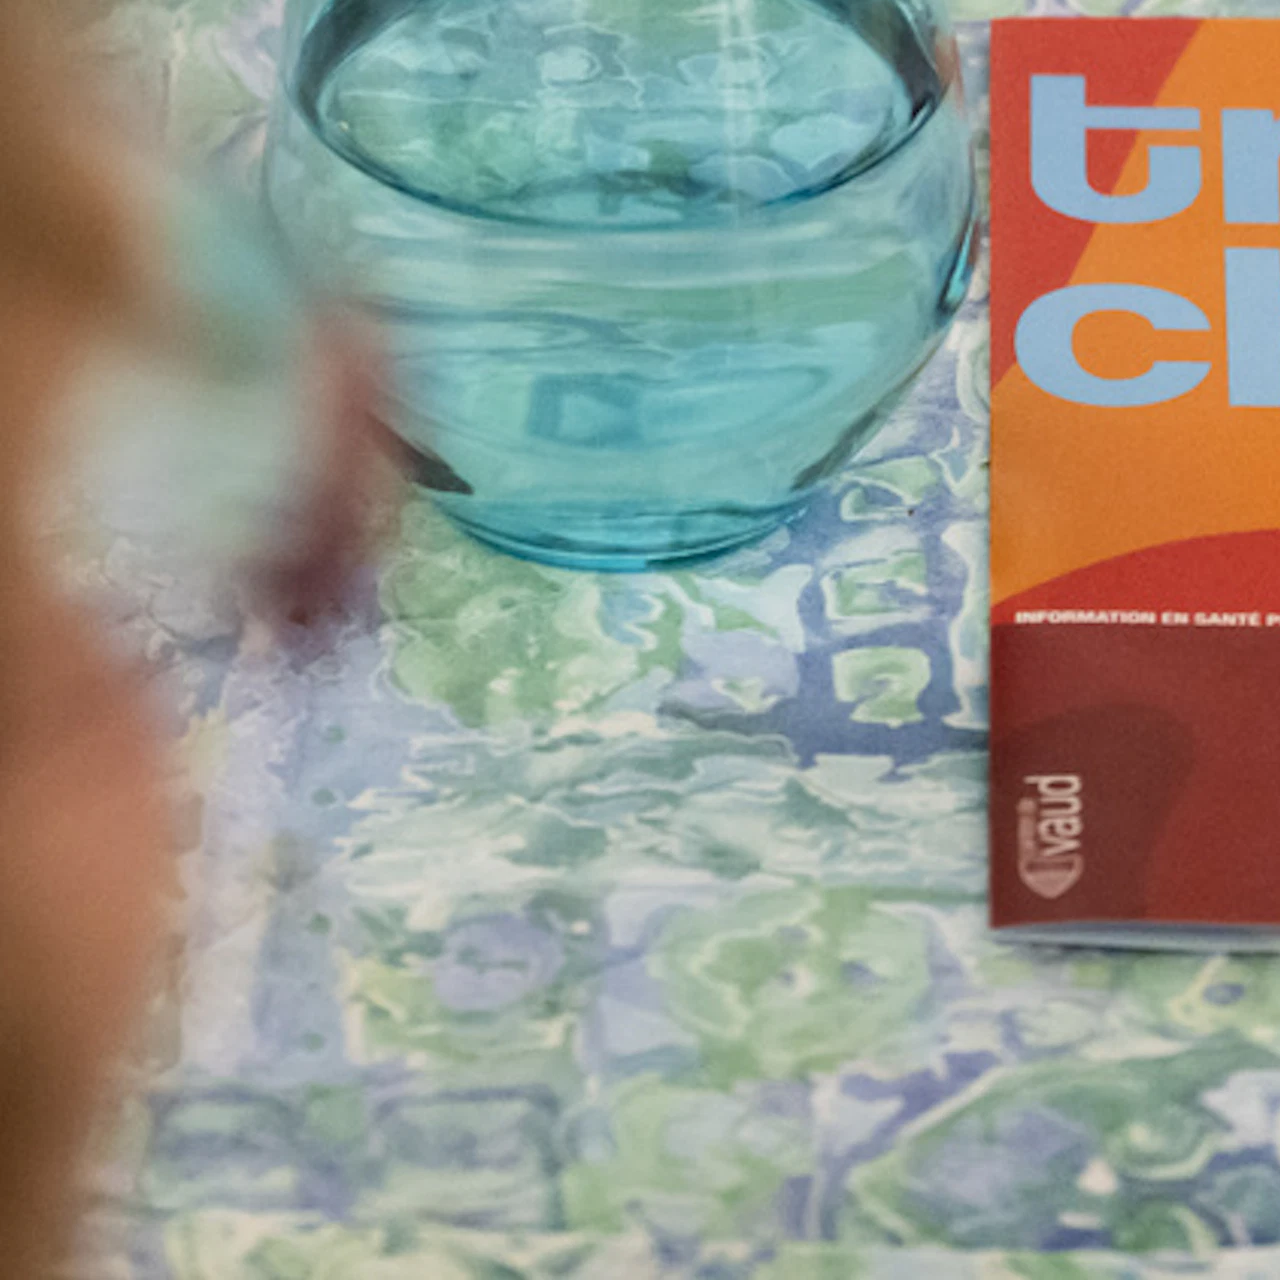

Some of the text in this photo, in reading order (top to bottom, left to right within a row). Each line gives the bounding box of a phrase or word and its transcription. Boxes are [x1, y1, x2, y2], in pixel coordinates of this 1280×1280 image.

[1015, 610, 1156, 625] INFORMATION
[1161, 612, 1189, 626] EN
[1194, 611, 1261, 627] SANTÉ
[1023, 774, 1083, 857] vaud
